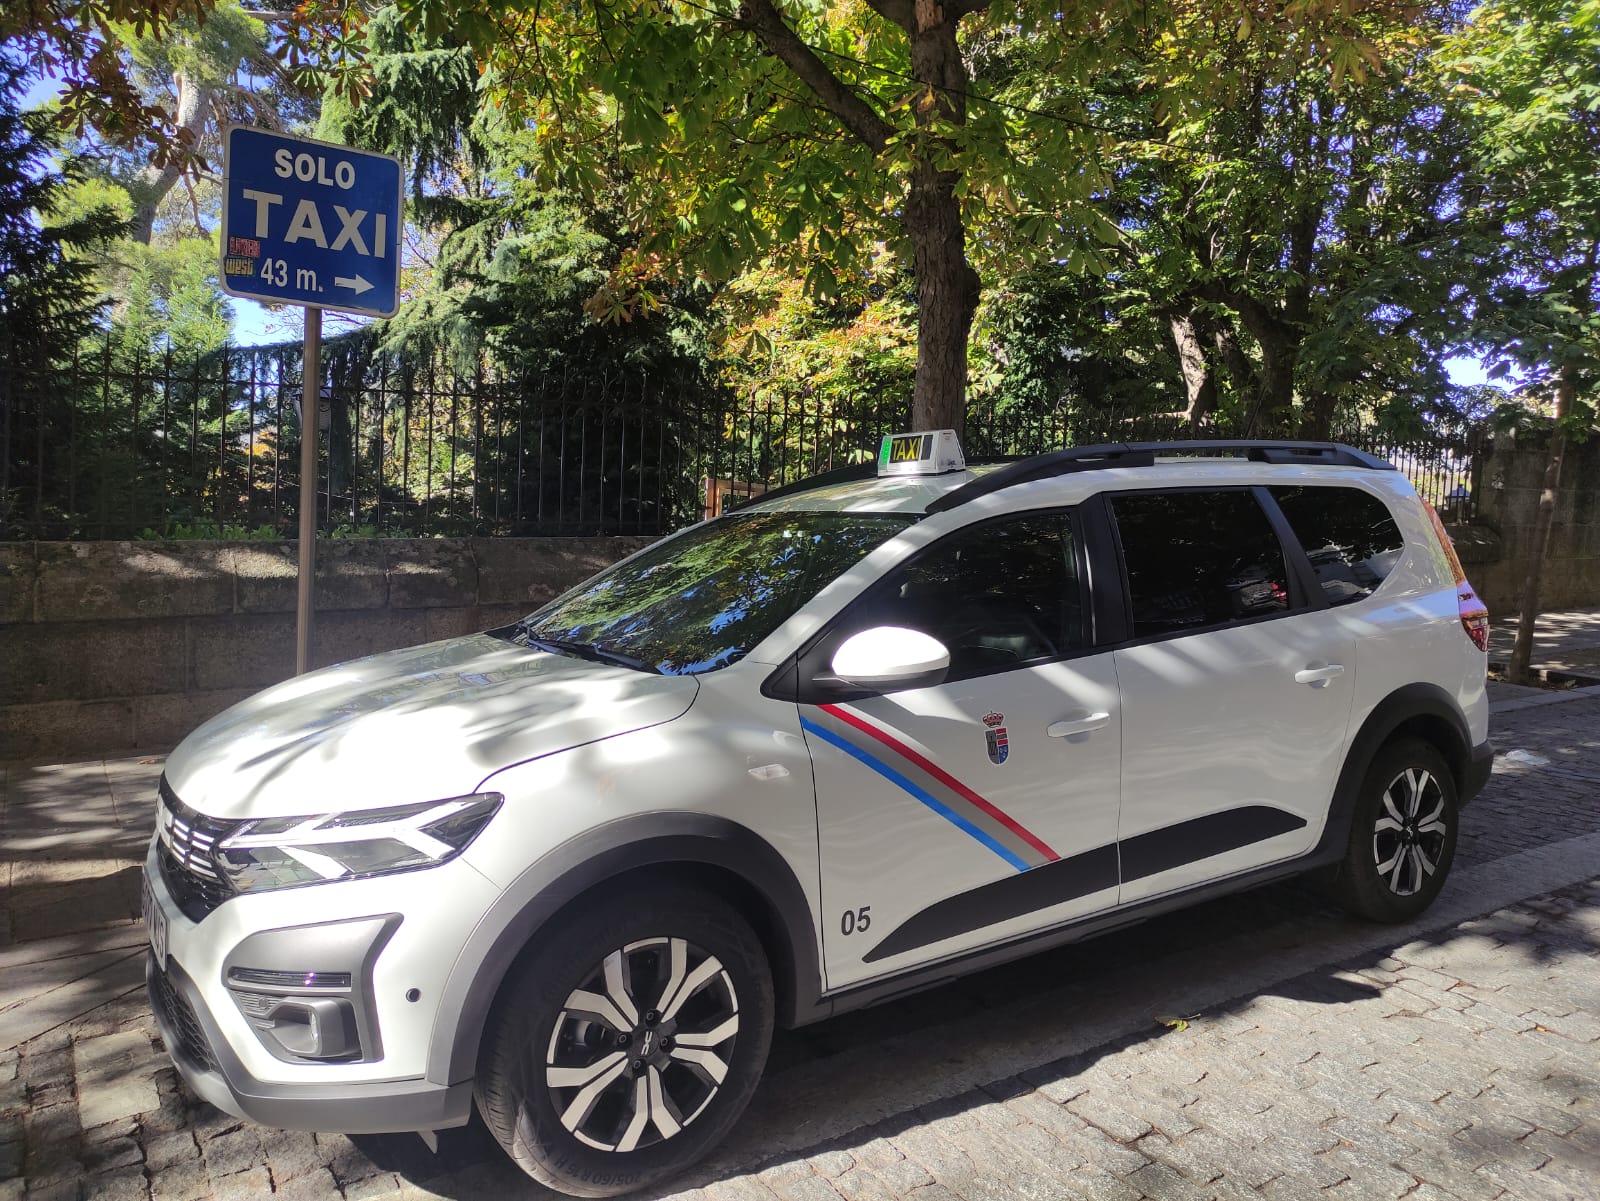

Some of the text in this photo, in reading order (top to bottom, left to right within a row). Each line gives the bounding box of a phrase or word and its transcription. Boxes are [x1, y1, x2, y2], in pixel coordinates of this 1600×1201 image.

[274, 149, 356, 190] SOLO
[243, 188, 386, 259] TAXI
[260, 257, 324, 292] 43 m.
[892, 438, 921, 461] TAXI
[841, 905, 871, 936] 05
